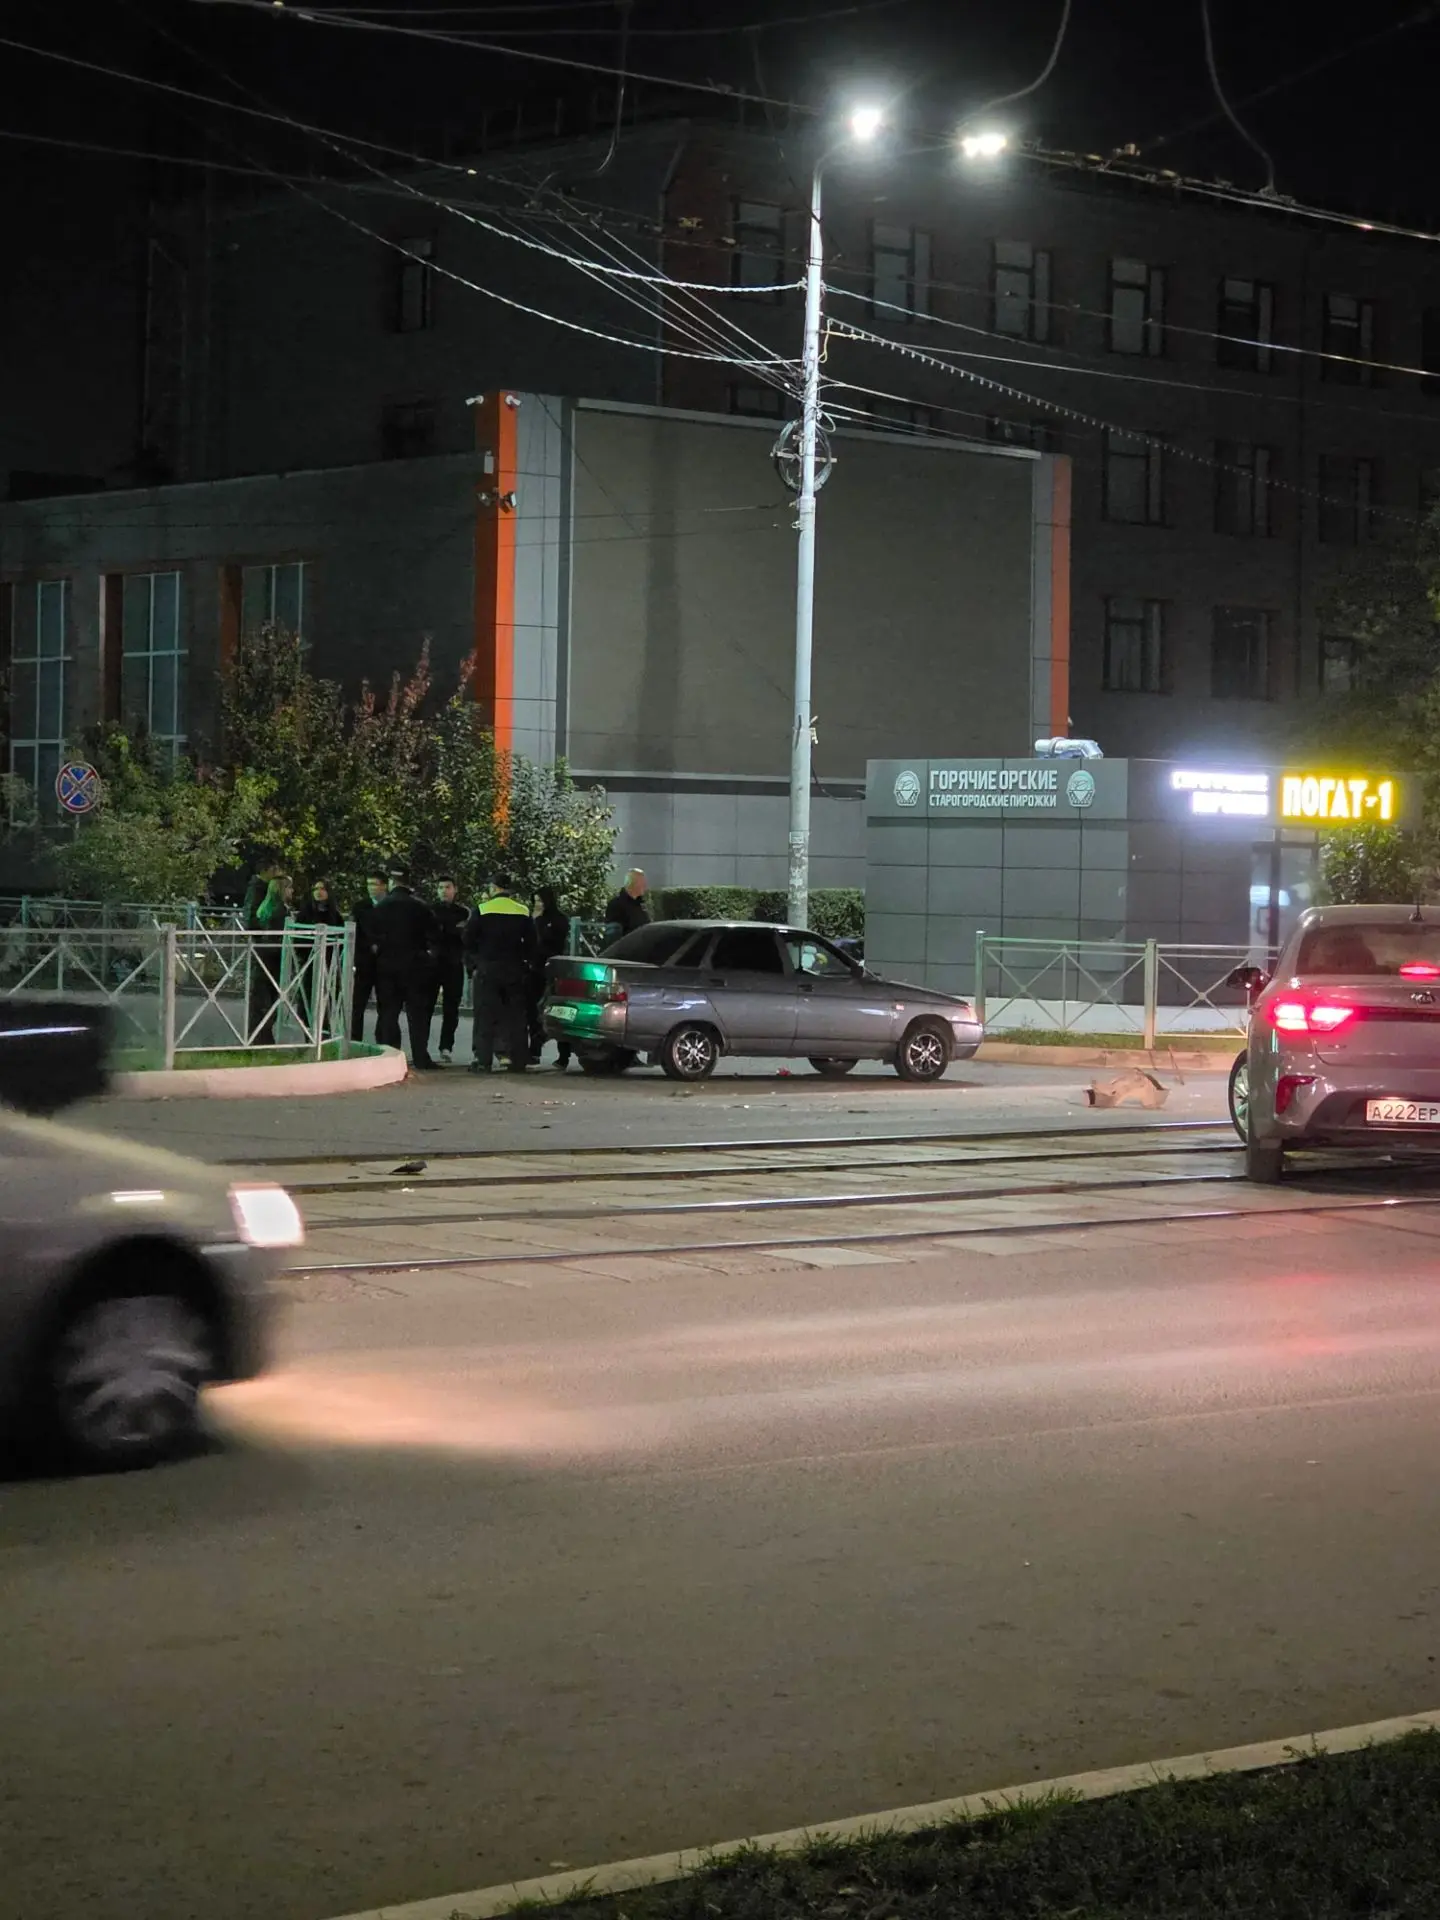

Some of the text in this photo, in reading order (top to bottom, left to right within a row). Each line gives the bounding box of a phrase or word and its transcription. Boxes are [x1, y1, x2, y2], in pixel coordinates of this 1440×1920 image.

[930, 770, 1057, 789] ГОРЯЧИЕ ОРСКИЕ
[929, 794, 1057, 808] СТАРОГОРОДСКИЕ ПИРОЖКИ
